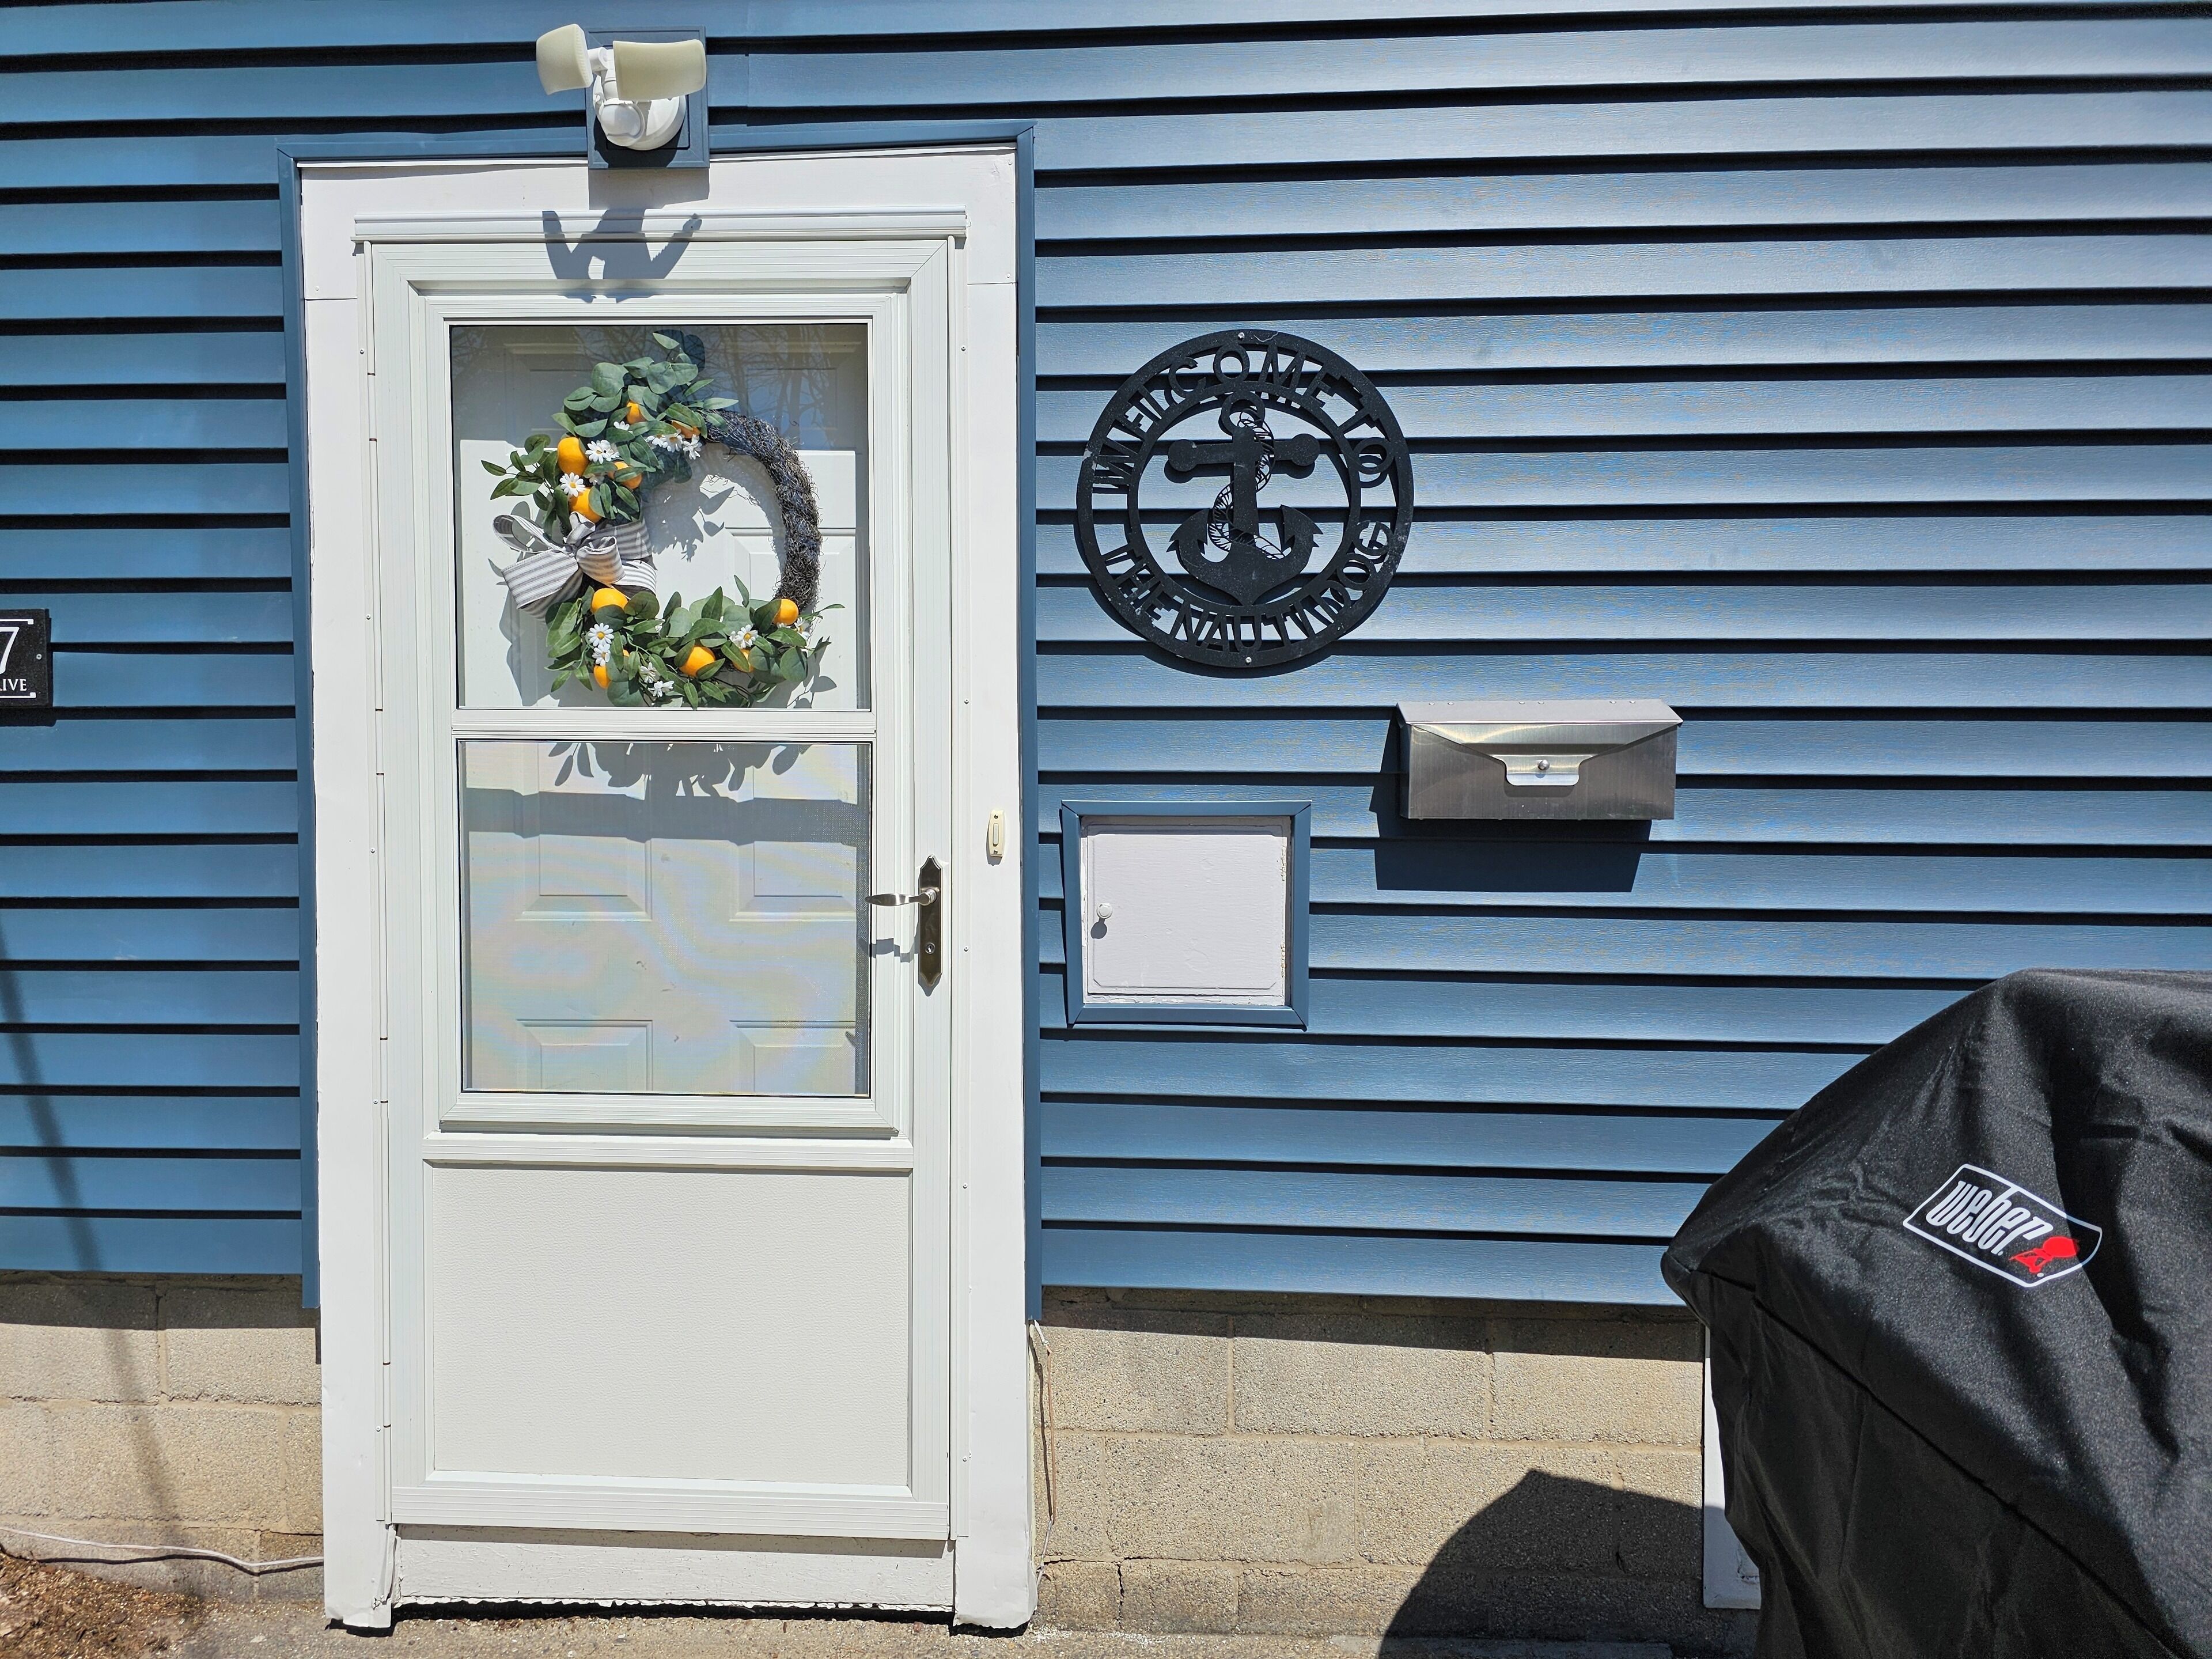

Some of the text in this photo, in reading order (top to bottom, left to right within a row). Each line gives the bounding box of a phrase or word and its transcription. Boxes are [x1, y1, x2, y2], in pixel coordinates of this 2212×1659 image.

[1092, 344, 1391, 487] WELCOME TO
[1101, 537, 1167, 622] THE
[1314, 520, 1393, 624] DOG
[0, 679, 27, 691] IVE
[1926, 1180, 2054, 1255] weber
